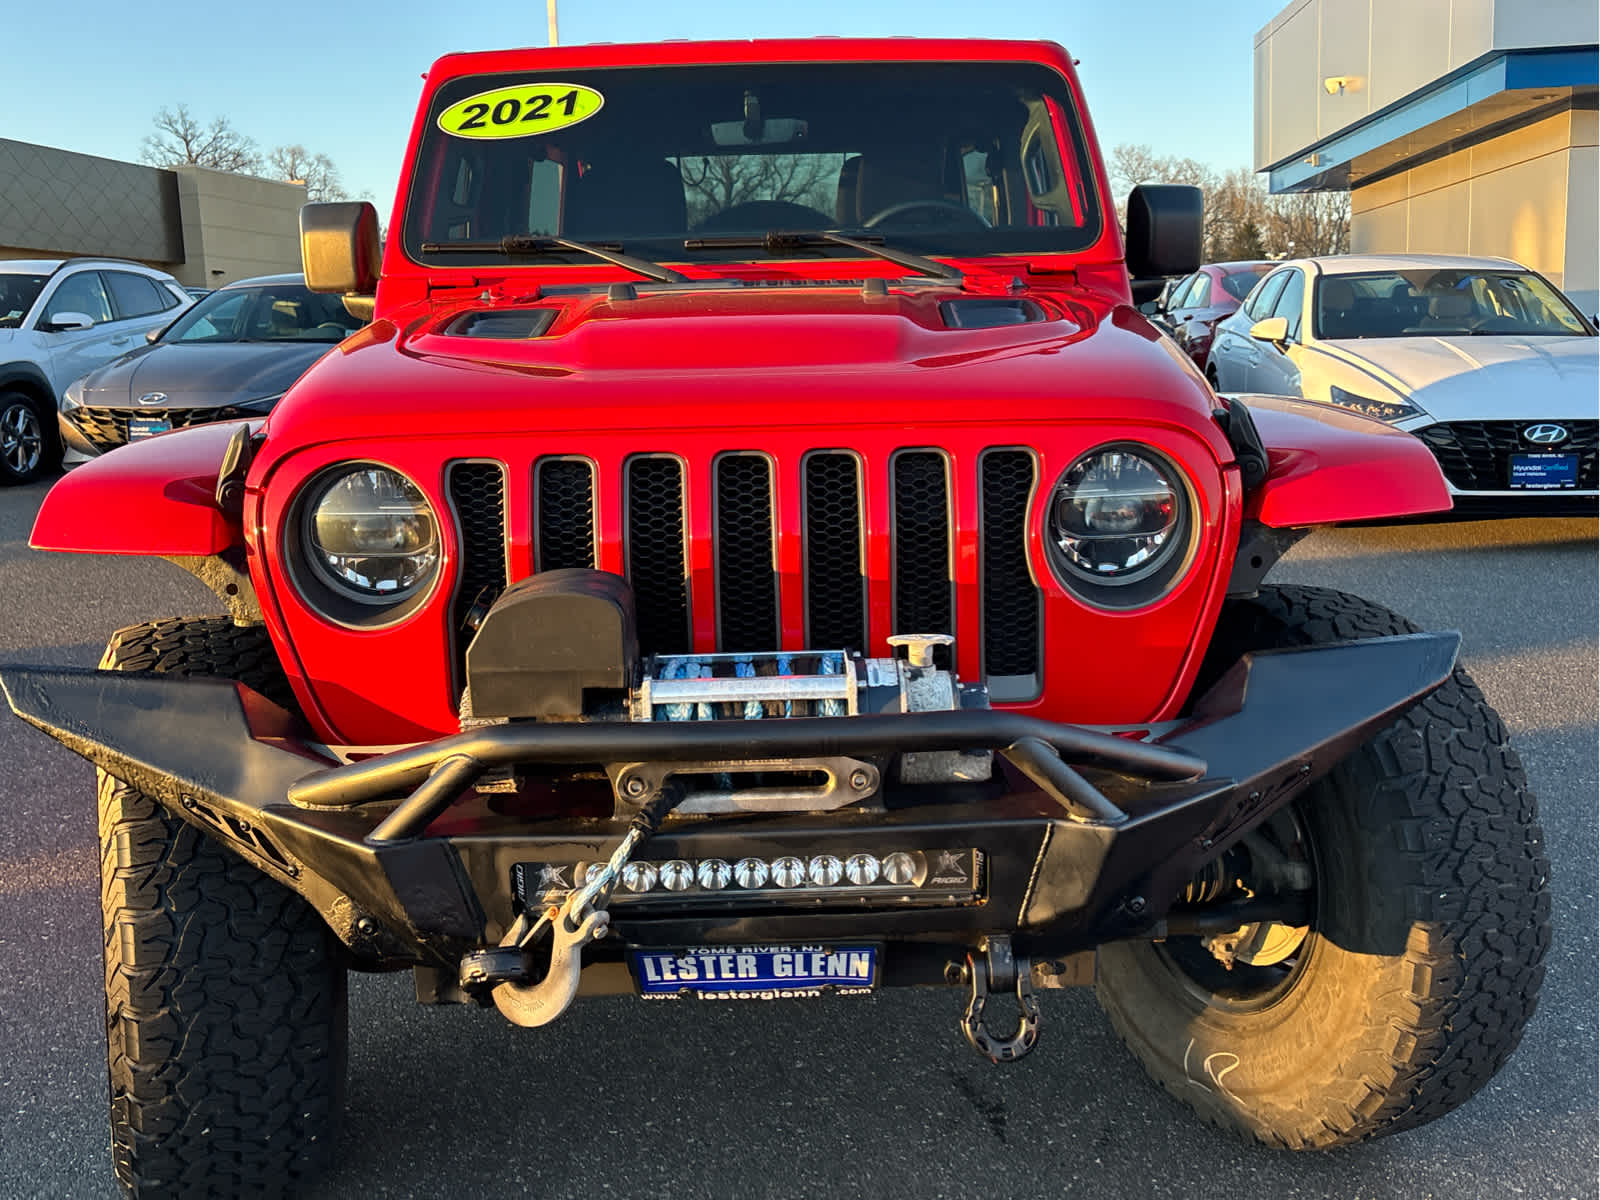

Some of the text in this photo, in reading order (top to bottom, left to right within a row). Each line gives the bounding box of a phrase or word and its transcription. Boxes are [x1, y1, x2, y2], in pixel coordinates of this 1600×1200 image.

[457, 90, 578, 131] 2021
[930, 876, 968, 885] RIGID
[687, 947, 736, 955] TOMS
[802, 944, 824, 952] NJ
[643, 952, 870, 982] LESTER GLENN
[697, 988, 821, 1001] lesterglenn
